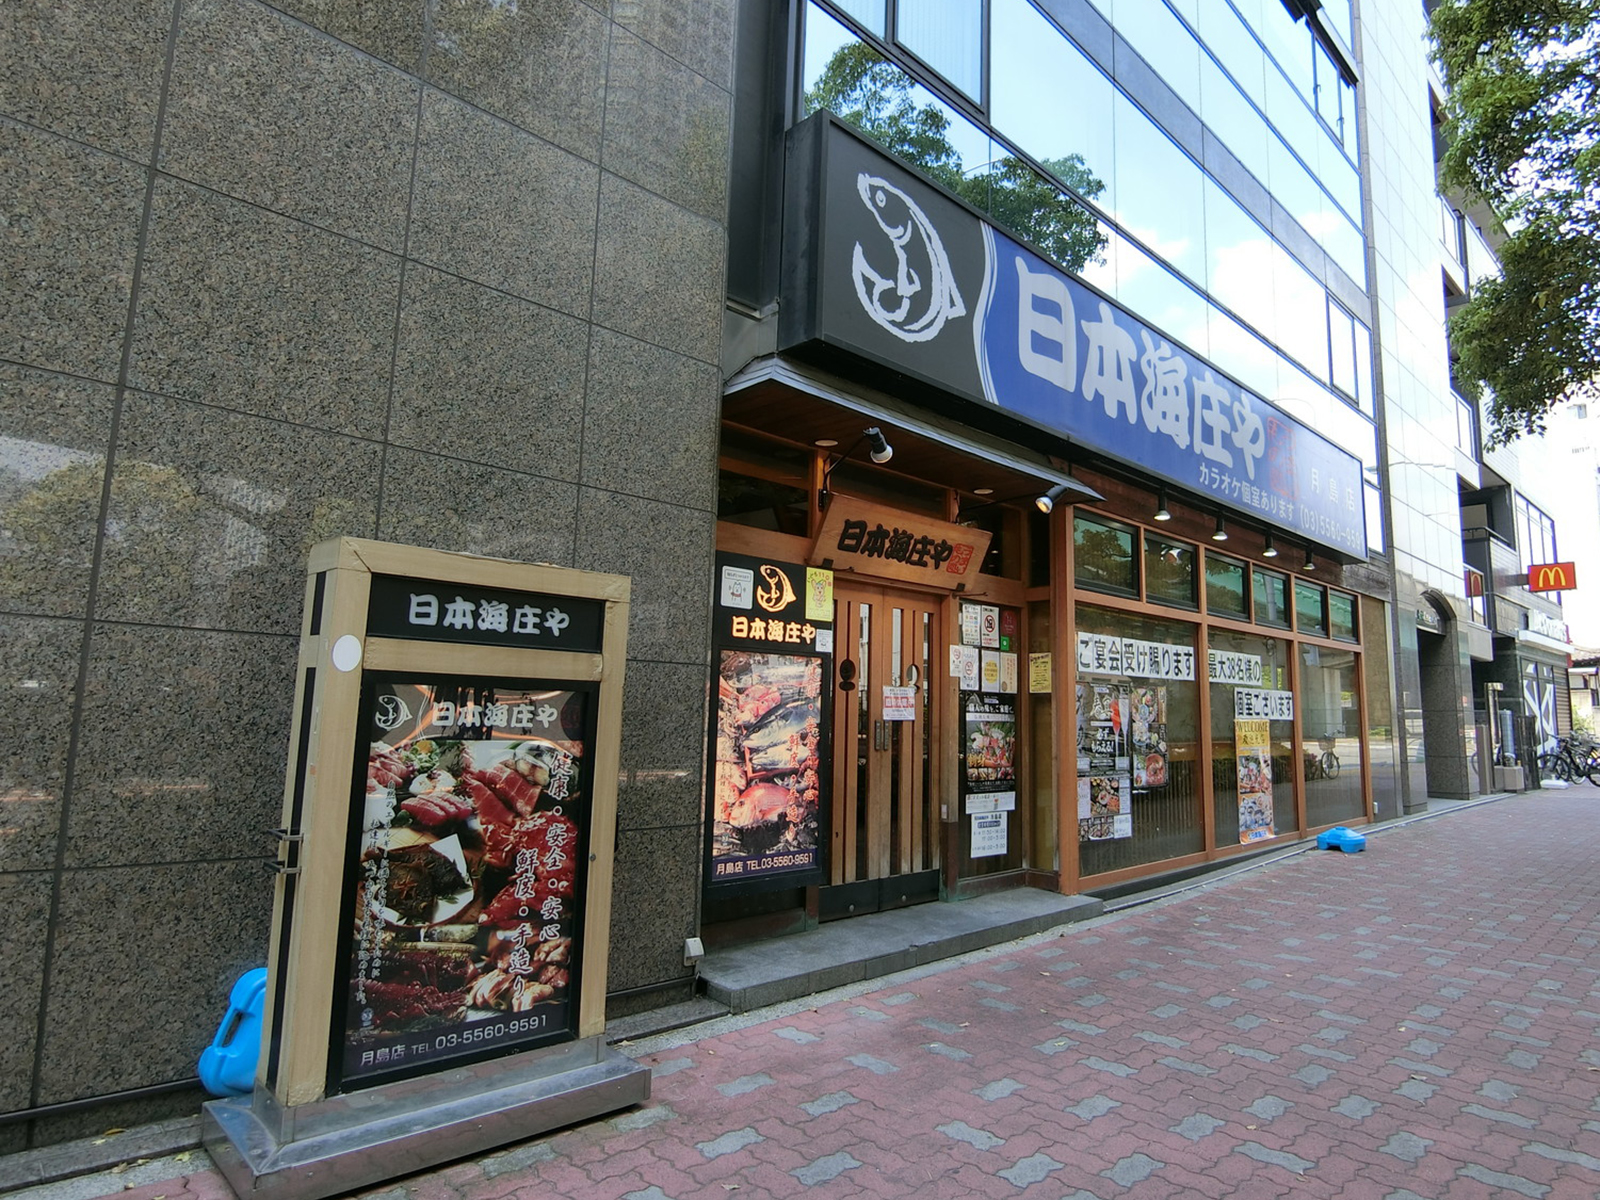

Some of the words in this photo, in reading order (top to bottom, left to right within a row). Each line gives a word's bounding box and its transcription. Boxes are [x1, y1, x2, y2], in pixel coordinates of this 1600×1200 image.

[1015, 256, 1265, 480] 日本海庄や
[1199, 462, 1294, 521] カラオケ個室あります
[837, 518, 954, 570] 日本海庄や
[408, 593, 570, 637] 日本海庄や
[731, 615, 816, 645] 日本海庄や
[1079, 637, 1194, 677] ご宴会受け賜ります
[1208, 652, 1262, 683] 最大38名様の
[431, 701, 558, 729] 日本海庄や
[1236, 690, 1293, 717] 個室ございます
[715, 861, 744, 875] 月島店
[360, 1045, 406, 1067] 月島店
